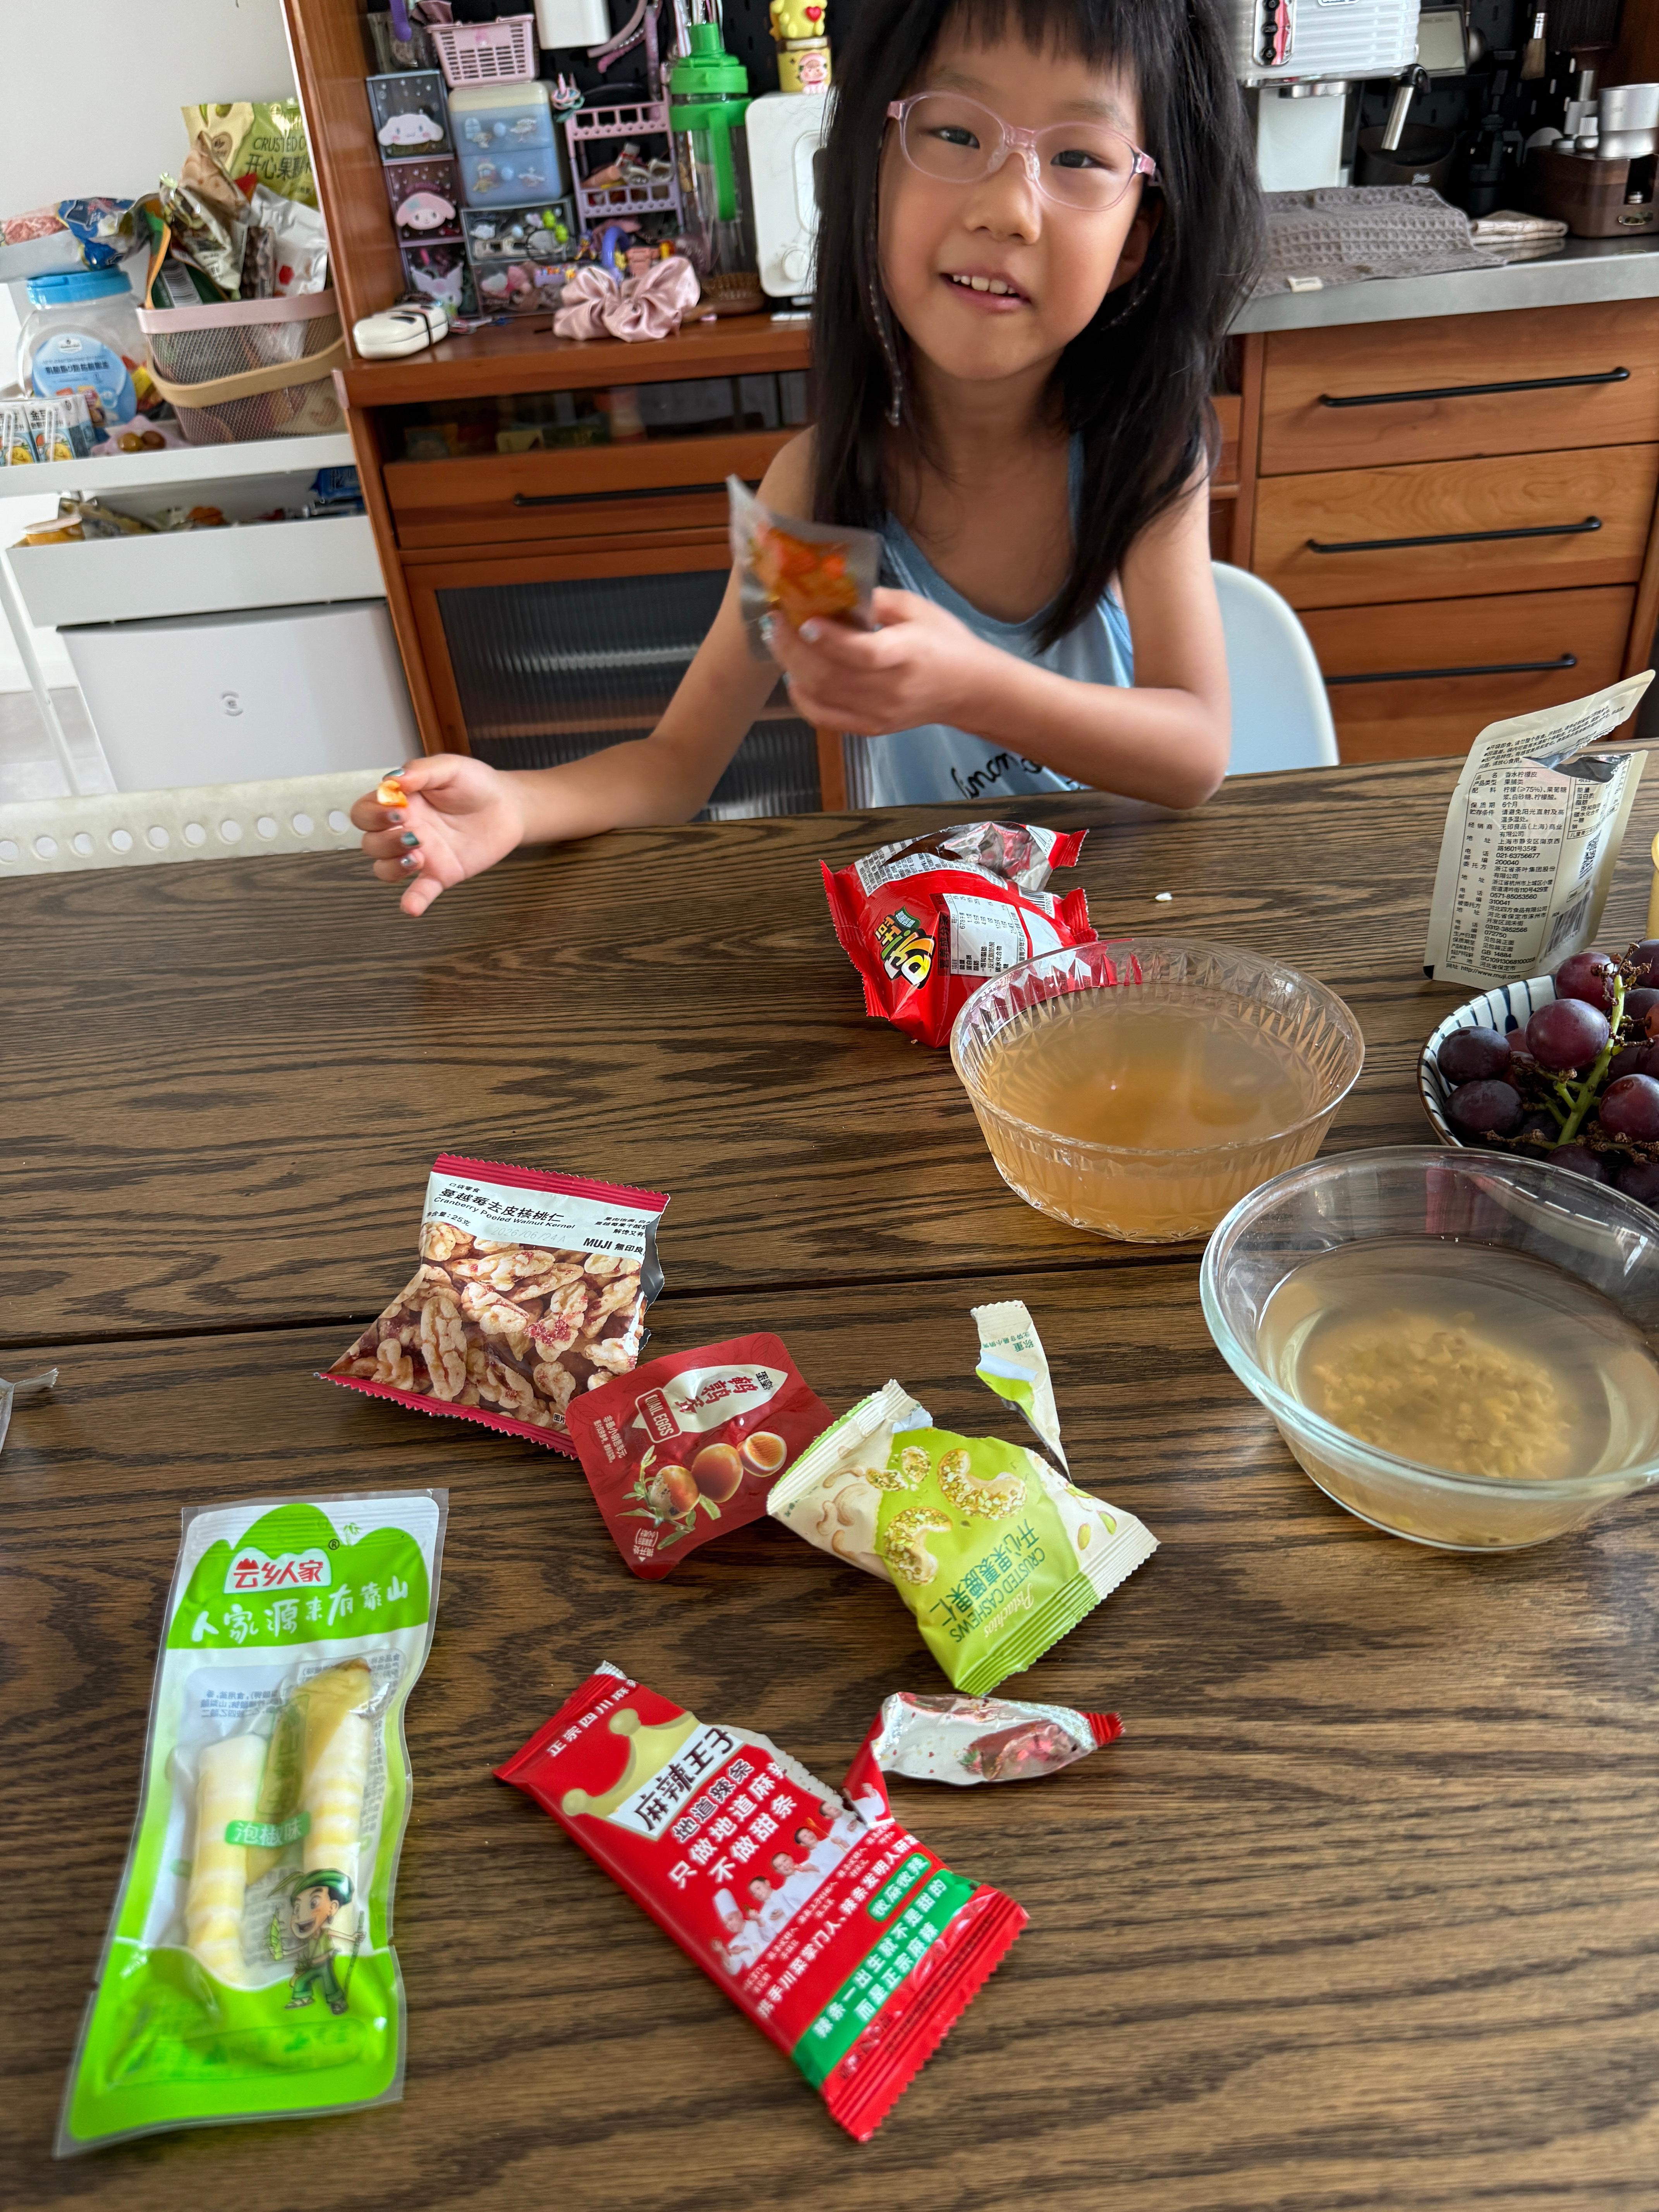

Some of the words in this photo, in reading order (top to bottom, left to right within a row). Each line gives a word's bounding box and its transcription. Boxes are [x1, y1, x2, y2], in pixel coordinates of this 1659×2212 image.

[1461, 965, 1520, 979] http://www.muji.com
[439, 1188, 565, 1223] 蔓越莓去皮核桃仁
[449, 1182, 480, 1193] 口袋零食
[434, 1197, 478, 1212] Cranberry
[480, 1209, 511, 1223] Peeled
[513, 1218, 543, 1226] Walnut
[583, 1238, 613, 1249] MUJI
[615, 1243, 645, 1255] 無印良
[613, 1229, 646, 1237] 解馋又有
[644, 1393, 664, 1416] QUAIL
[675, 1376, 759, 1414] 鹌鹑蛋
[653, 1413, 673, 1437] EGGS
[930, 1518, 1039, 1622] 开心果裹腰果仁
[1000, 1545, 1047, 1595] CRUSTED
[949, 1584, 1006, 1645] CASHEWS
[984, 1588, 1035, 1638] Pistachios
[634, 1727, 735, 1831] 麻辣王子
[672, 1758, 754, 1844] 地道辣条
[236, 1819, 302, 1845] 泡椒味
[709, 1795, 798, 1884] 不做甜条
[812, 1880, 948, 2040] 辣条一出生就不是甜的
[854, 1923, 940, 2021] 而是正宗麻辣
